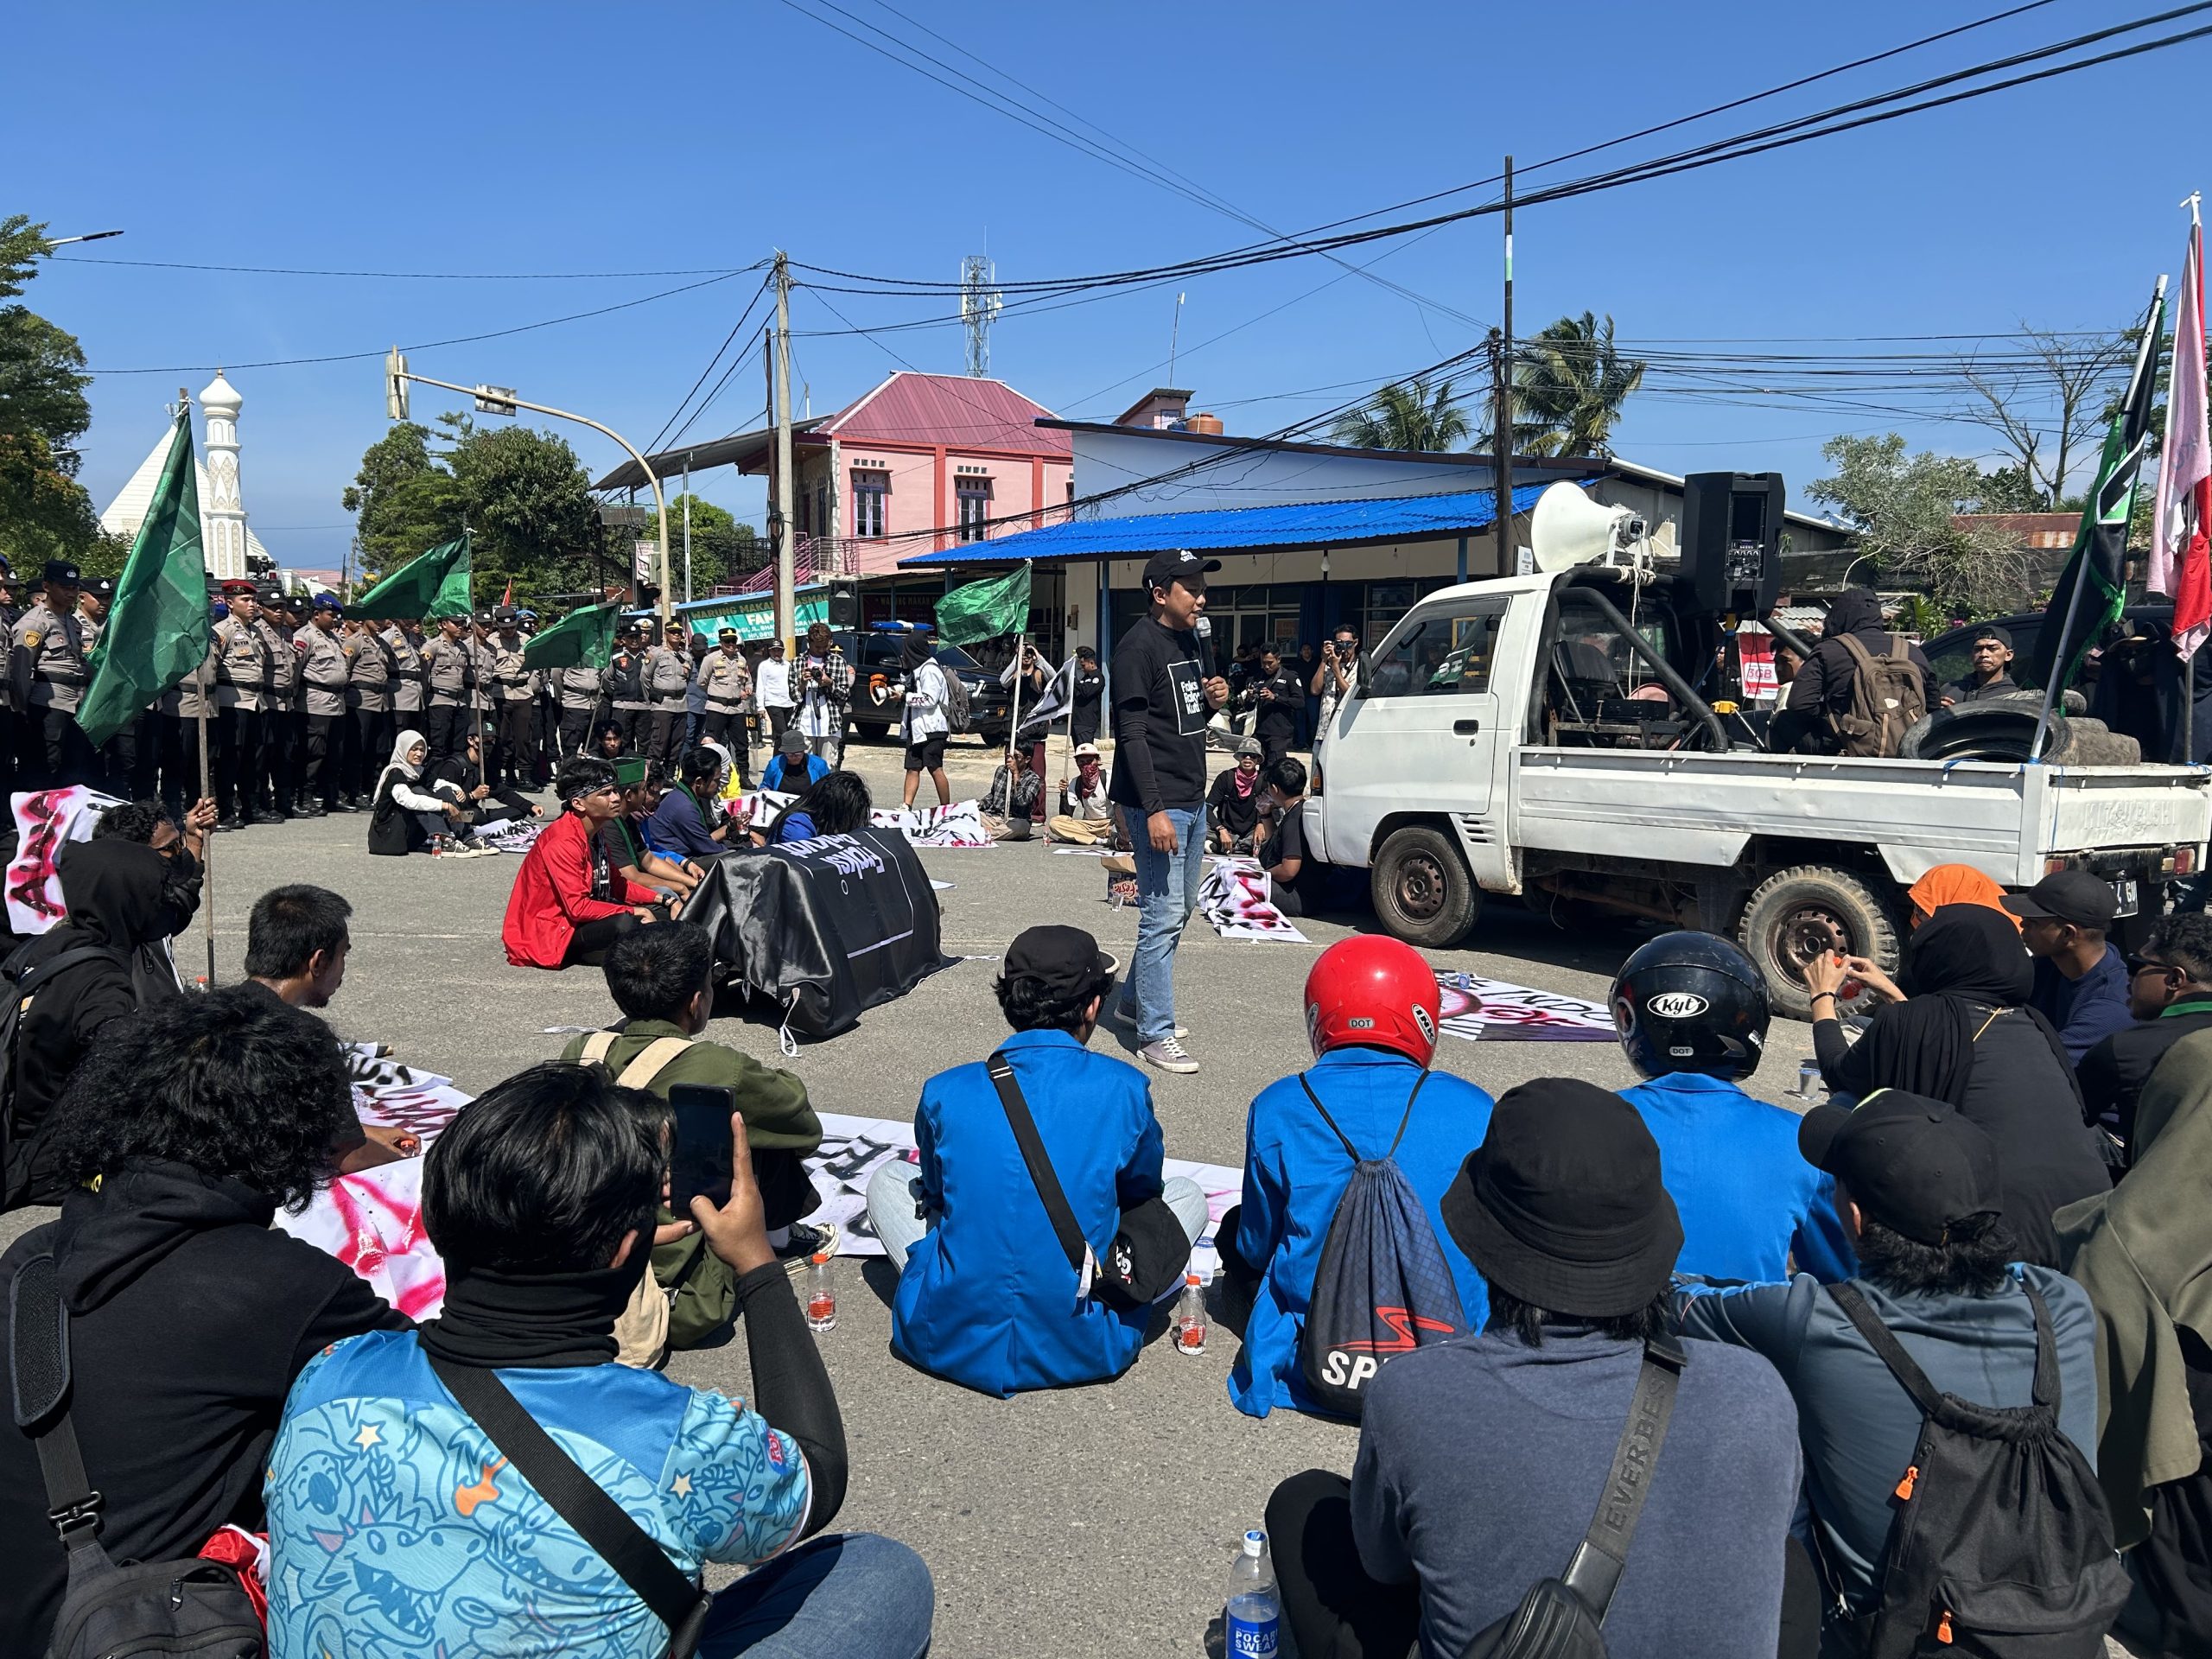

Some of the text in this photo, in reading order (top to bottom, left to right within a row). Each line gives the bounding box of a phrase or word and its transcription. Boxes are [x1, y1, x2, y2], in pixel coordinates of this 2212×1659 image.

[691, 607, 736, 620] WARUNG
[1748, 668, 1772, 679] 3GB
[1180, 680, 1198, 692] Fraks
[819, 846, 885, 880] Fraksi
[1351, 1019, 1371, 1028] DOT
[1415, 1008, 1435, 1039] INK
[1235, 1628, 1278, 1643] POCARI
[1235, 1639, 1276, 1652] SWEAT
